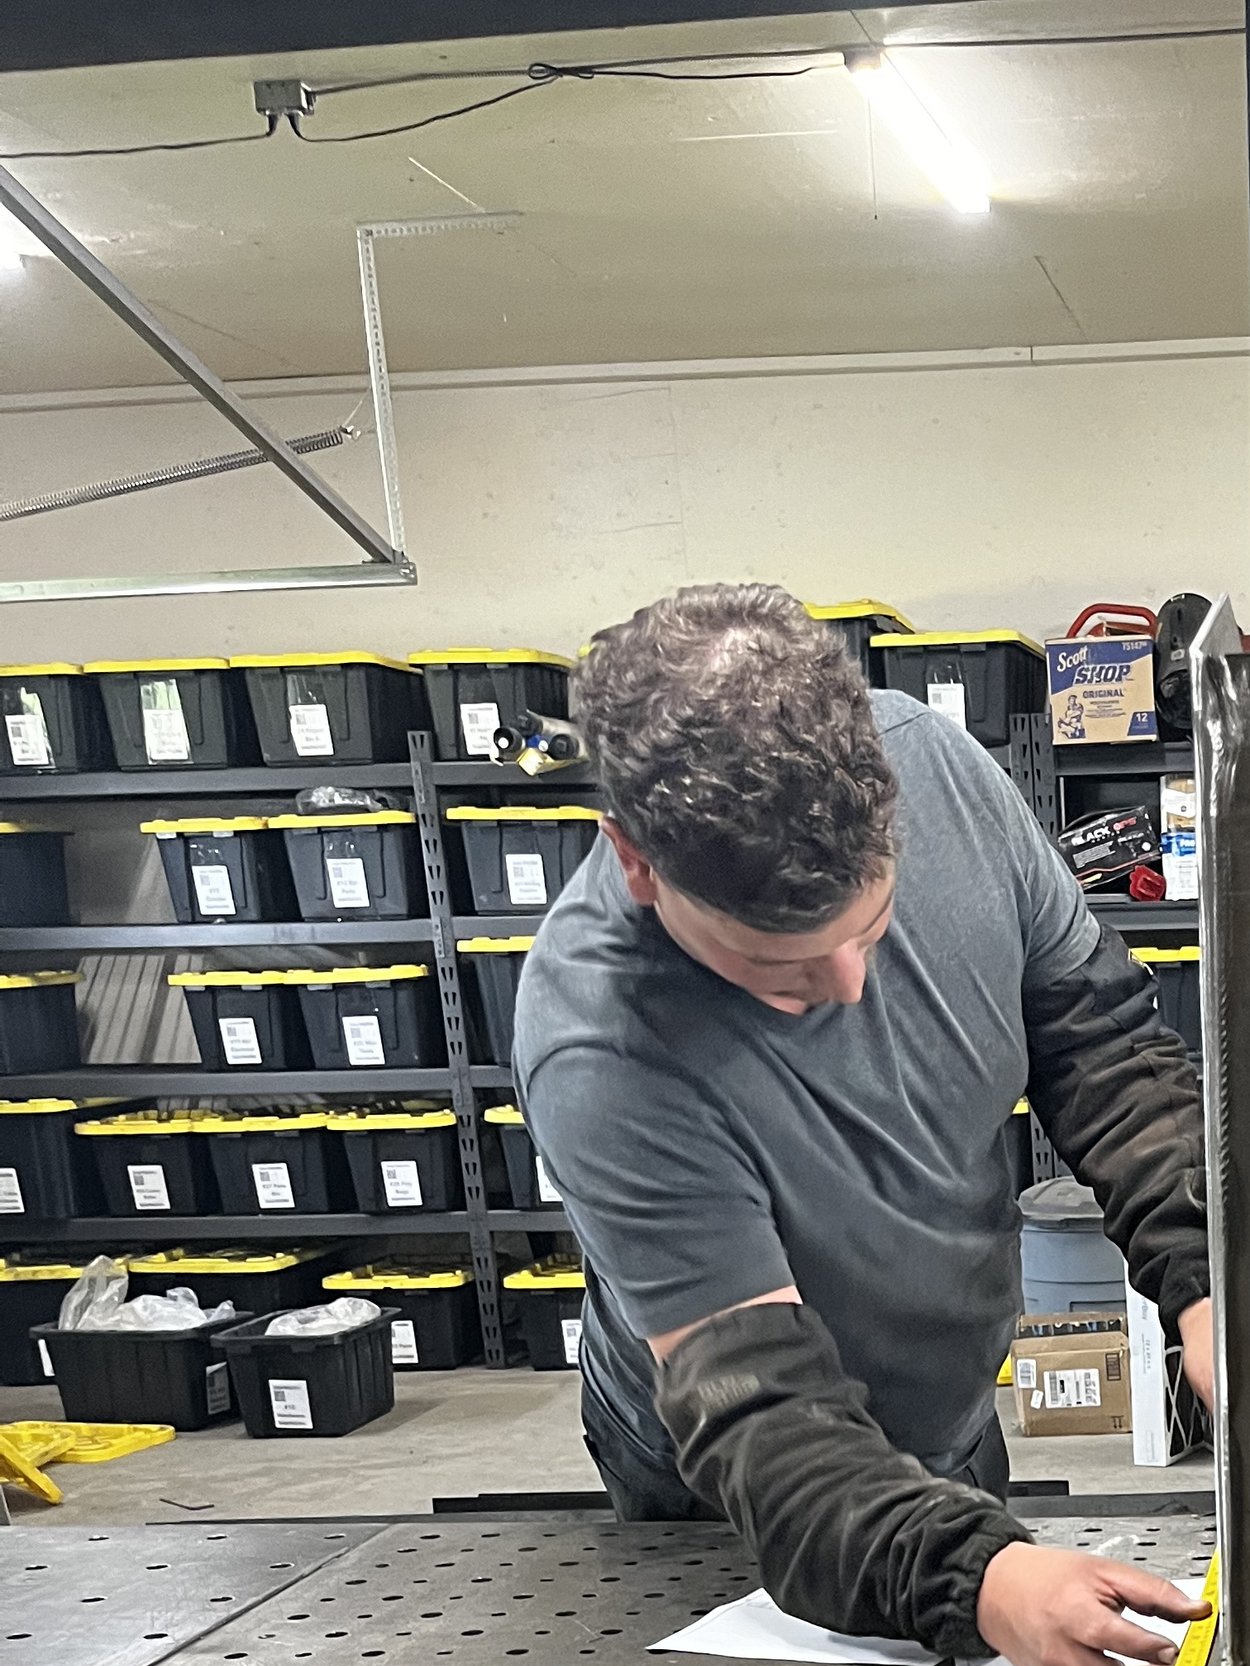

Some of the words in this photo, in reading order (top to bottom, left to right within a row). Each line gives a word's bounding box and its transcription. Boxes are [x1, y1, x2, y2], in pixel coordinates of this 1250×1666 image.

[1057, 645, 1088, 672] Scott
[1073, 664, 1131, 684] SHOP
[1083, 688, 1124, 698] ORIGINAL
[1136, 713, 1148, 722] 12
